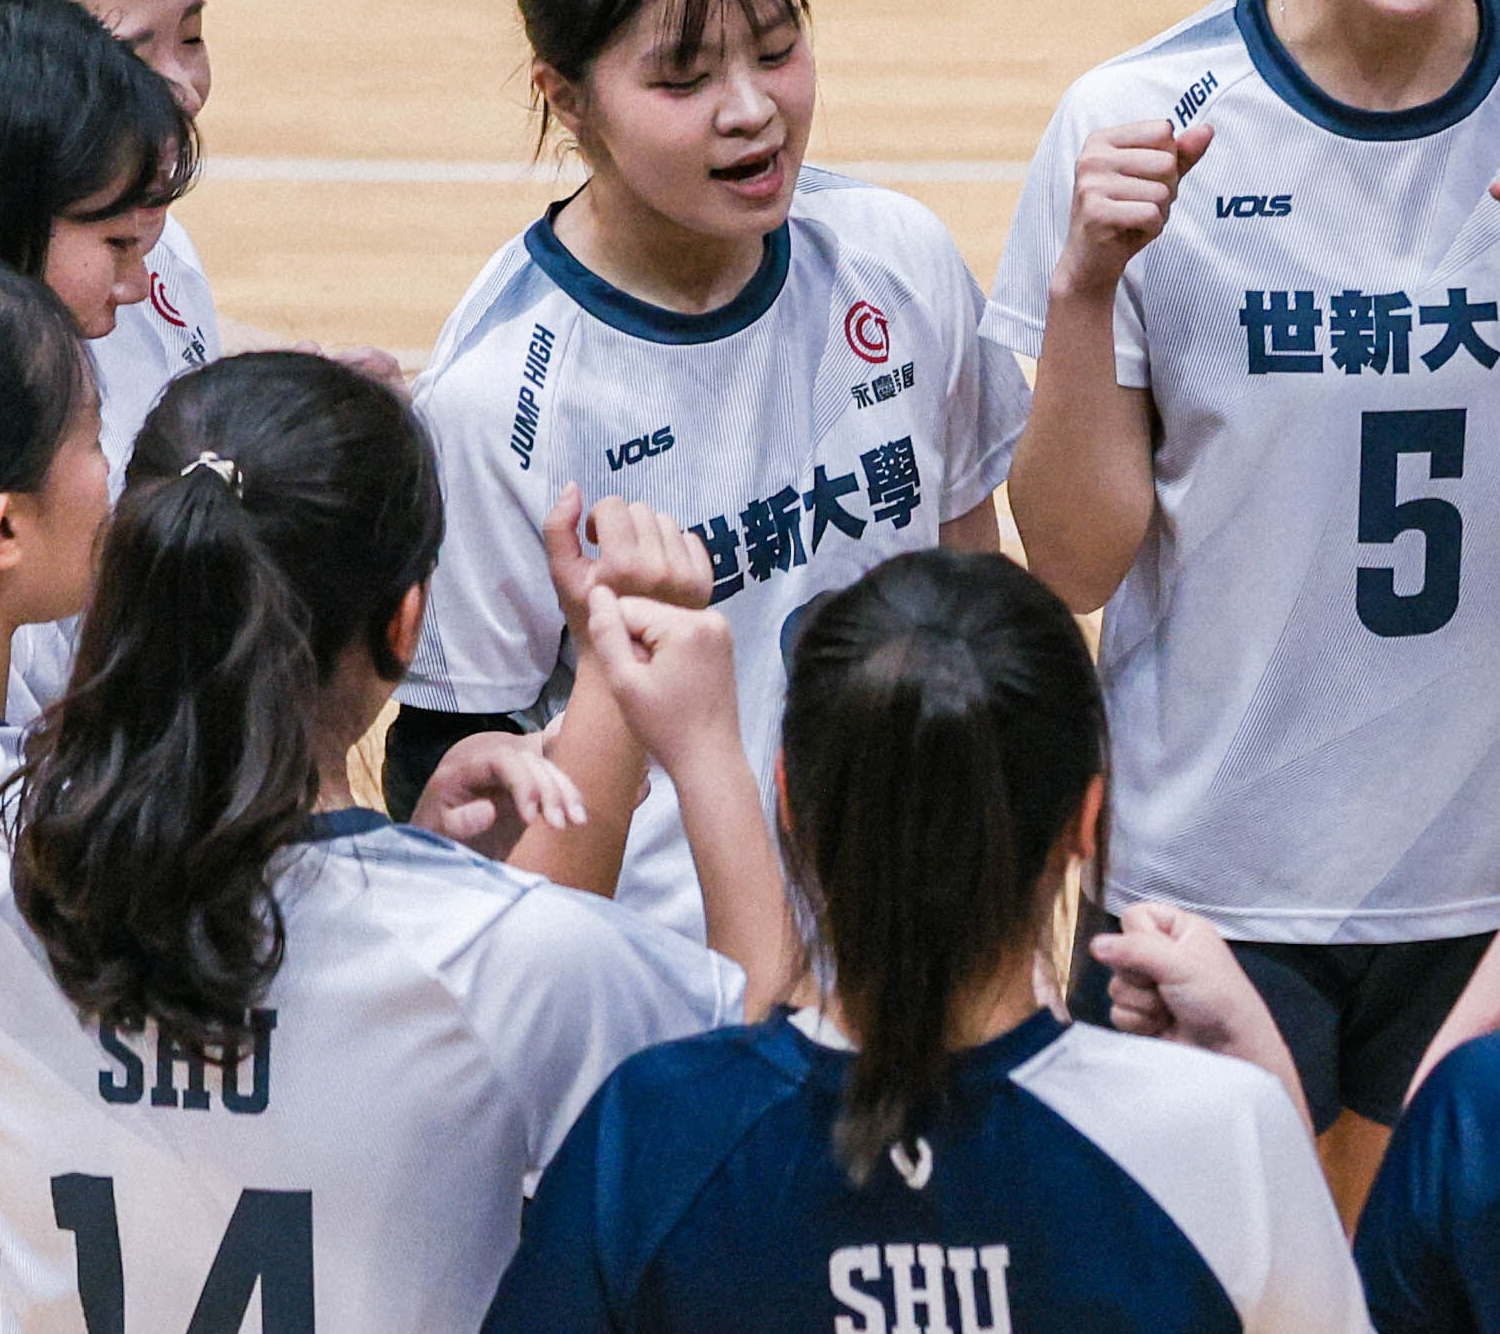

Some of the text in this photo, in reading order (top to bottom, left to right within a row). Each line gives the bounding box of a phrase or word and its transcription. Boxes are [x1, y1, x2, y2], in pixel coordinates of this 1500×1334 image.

[1174, 70, 1219, 128] HIGH
[1215, 194, 1293, 219] VOLS
[510, 323, 555, 470] JUMP HIGH
[606, 425, 675, 471] VOLS
[686, 436, 921, 606] 世新大學
[1356, 407, 1468, 638] 5
